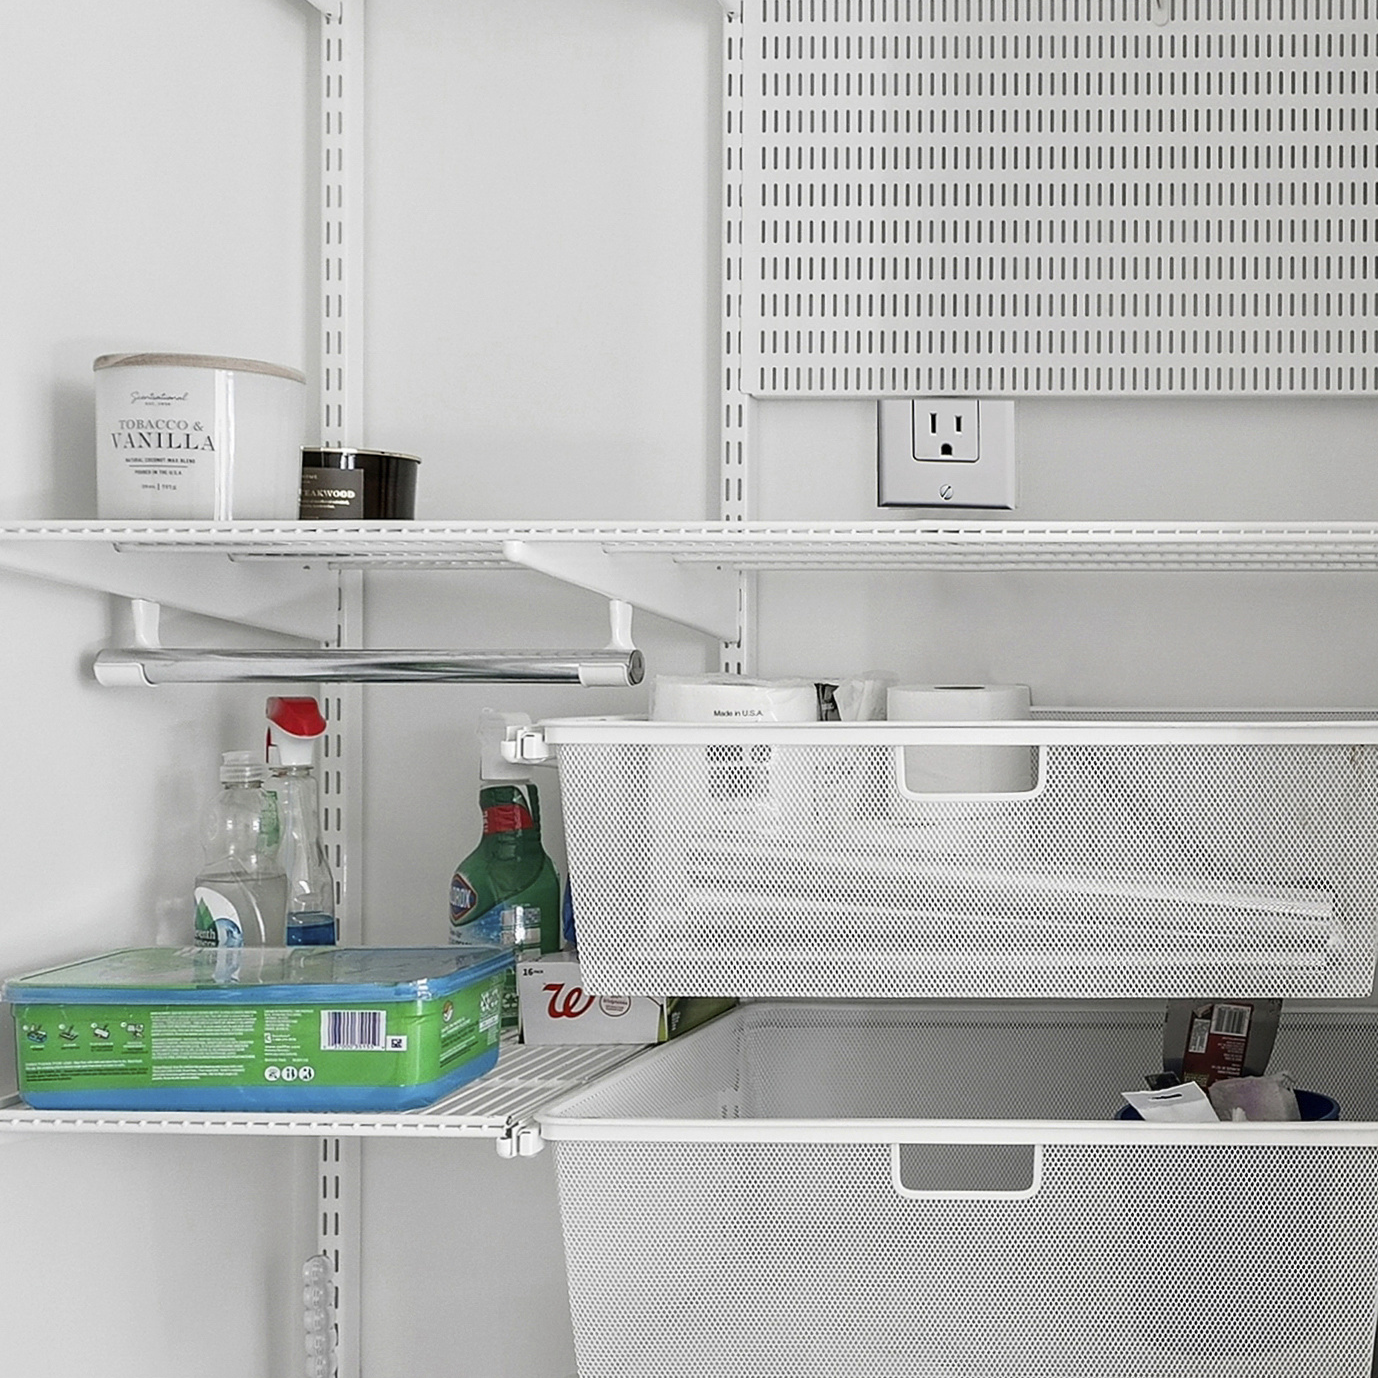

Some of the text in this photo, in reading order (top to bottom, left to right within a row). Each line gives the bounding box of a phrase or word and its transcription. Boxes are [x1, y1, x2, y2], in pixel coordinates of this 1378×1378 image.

[118, 418, 204, 432] TOBACCO &
[111, 432, 216, 452] VANILLA
[302, 489, 356, 499] EAKWOOD
[713, 709, 733, 717] Made
[734, 709, 741, 717] in
[523, 968, 534, 977] 16
